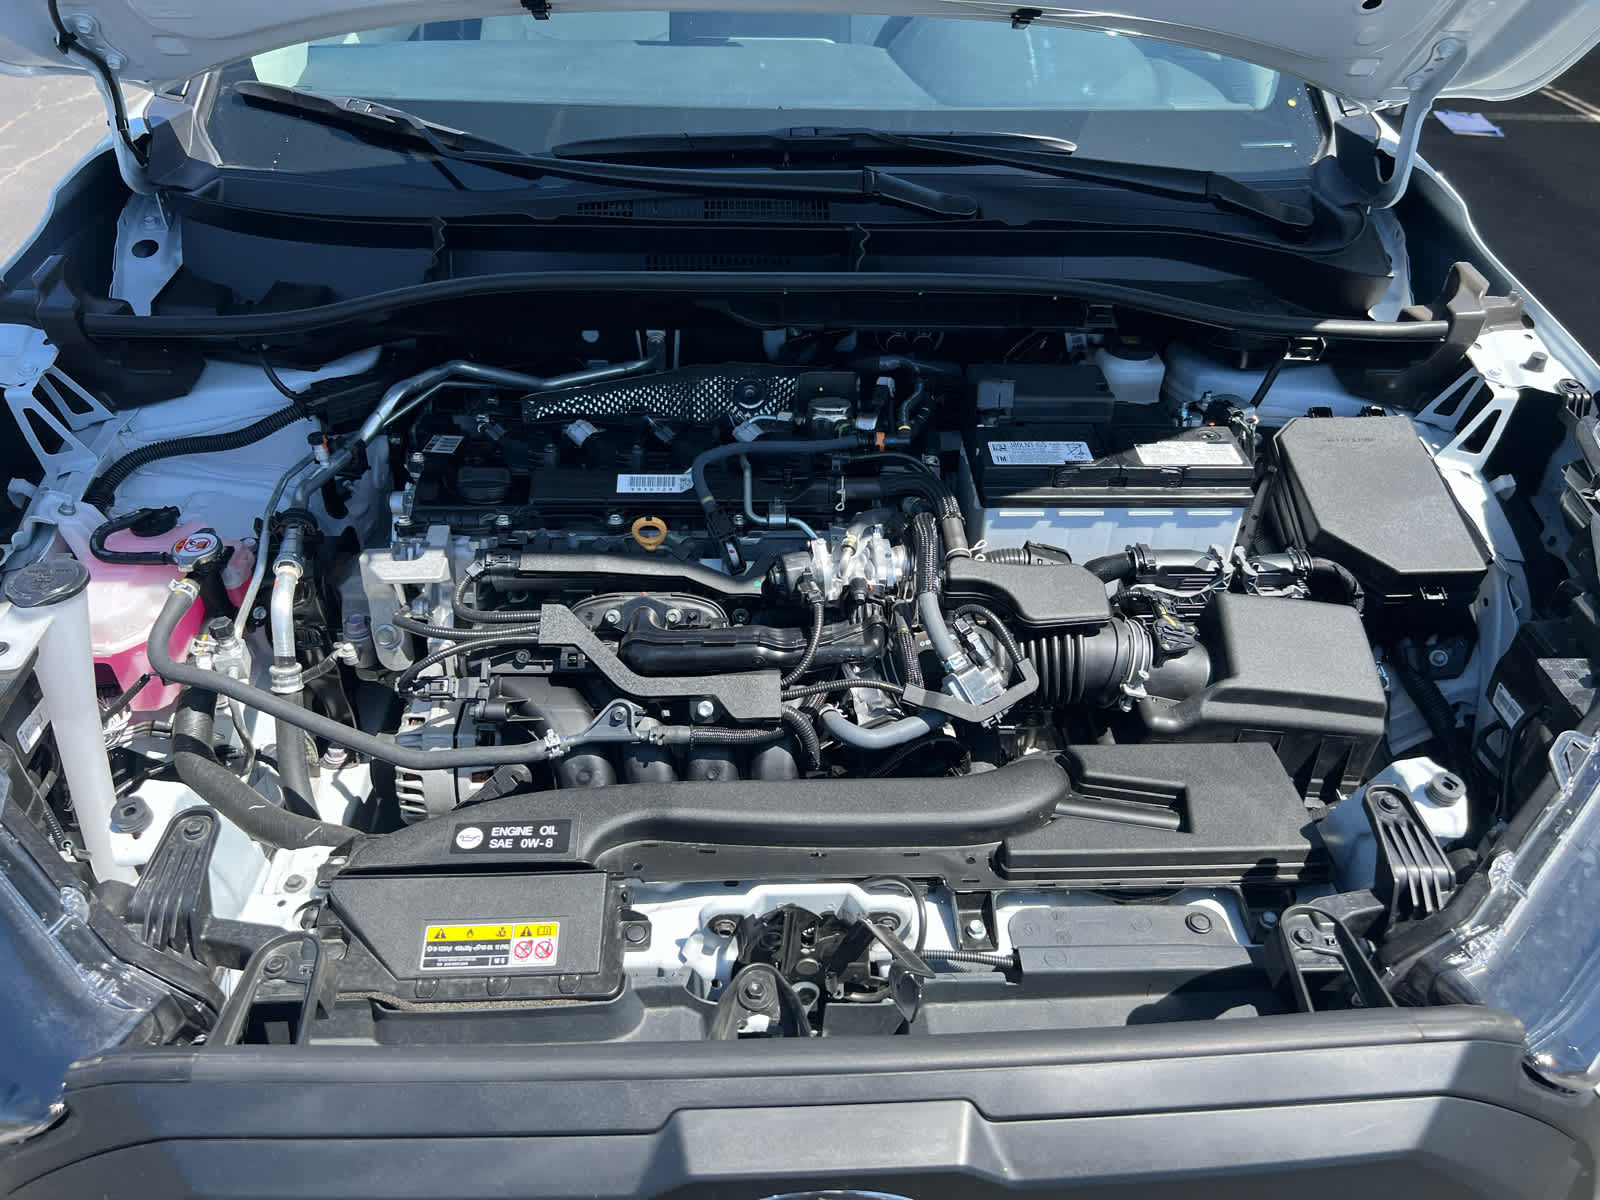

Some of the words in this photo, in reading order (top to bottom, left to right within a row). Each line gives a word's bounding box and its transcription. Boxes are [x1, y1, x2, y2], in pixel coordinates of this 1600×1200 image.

[491, 826, 534, 836] ENGINE
[539, 825, 559, 835] OIL
[488, 838, 514, 848] SAE
[520, 838, 553, 848] 0W-8
